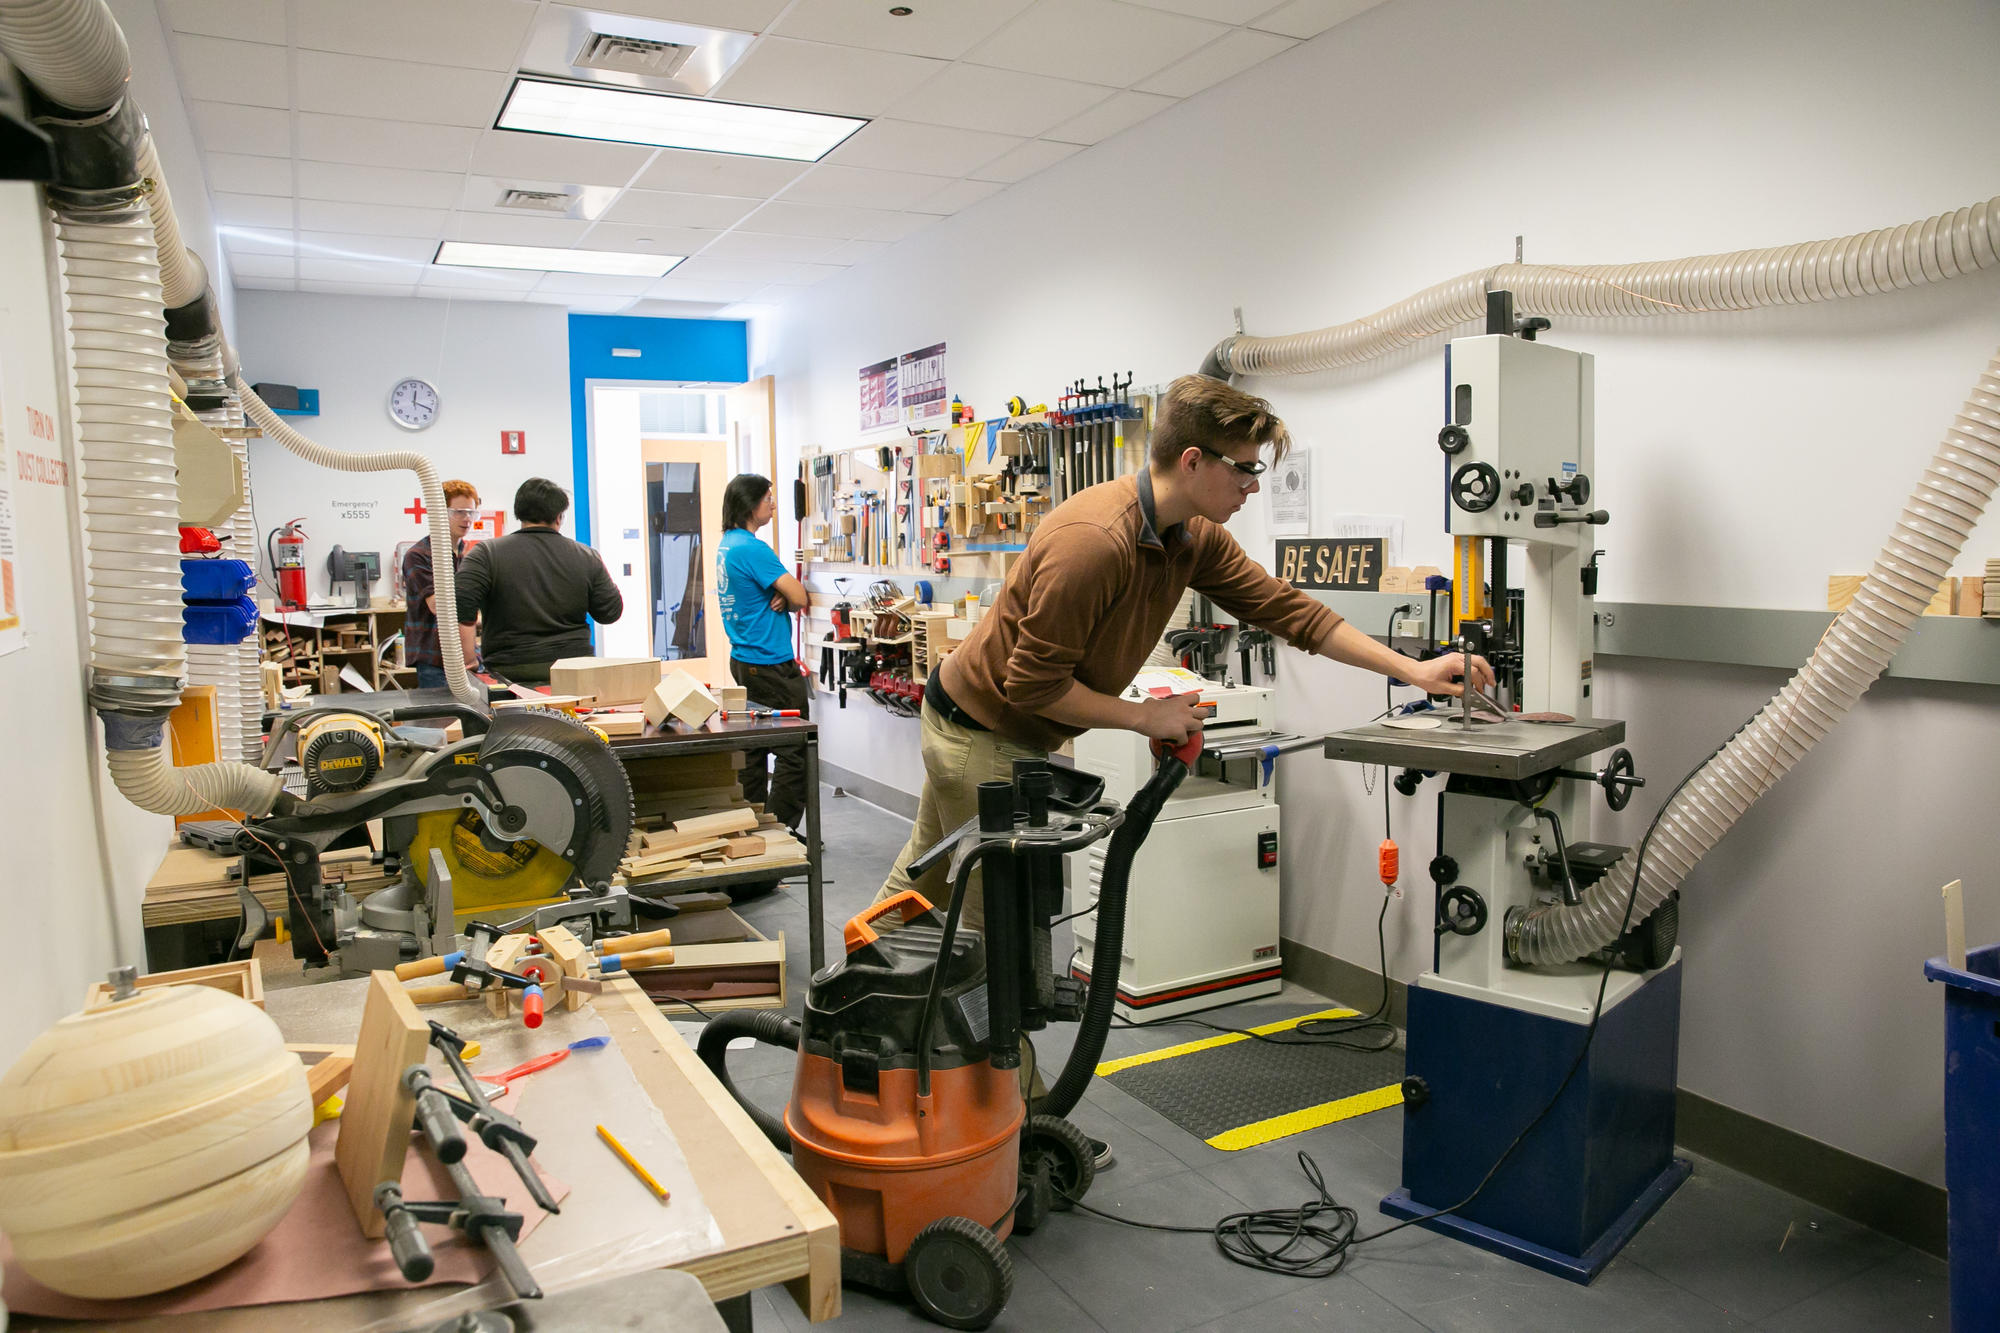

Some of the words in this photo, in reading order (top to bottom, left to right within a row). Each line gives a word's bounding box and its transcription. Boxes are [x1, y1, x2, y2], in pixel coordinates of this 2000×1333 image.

[331, 500, 378, 508] Emergency?
[341, 510, 370, 519] x5555
[1282, 545, 1311, 583] BE
[1313, 544, 1374, 584] SAFE
